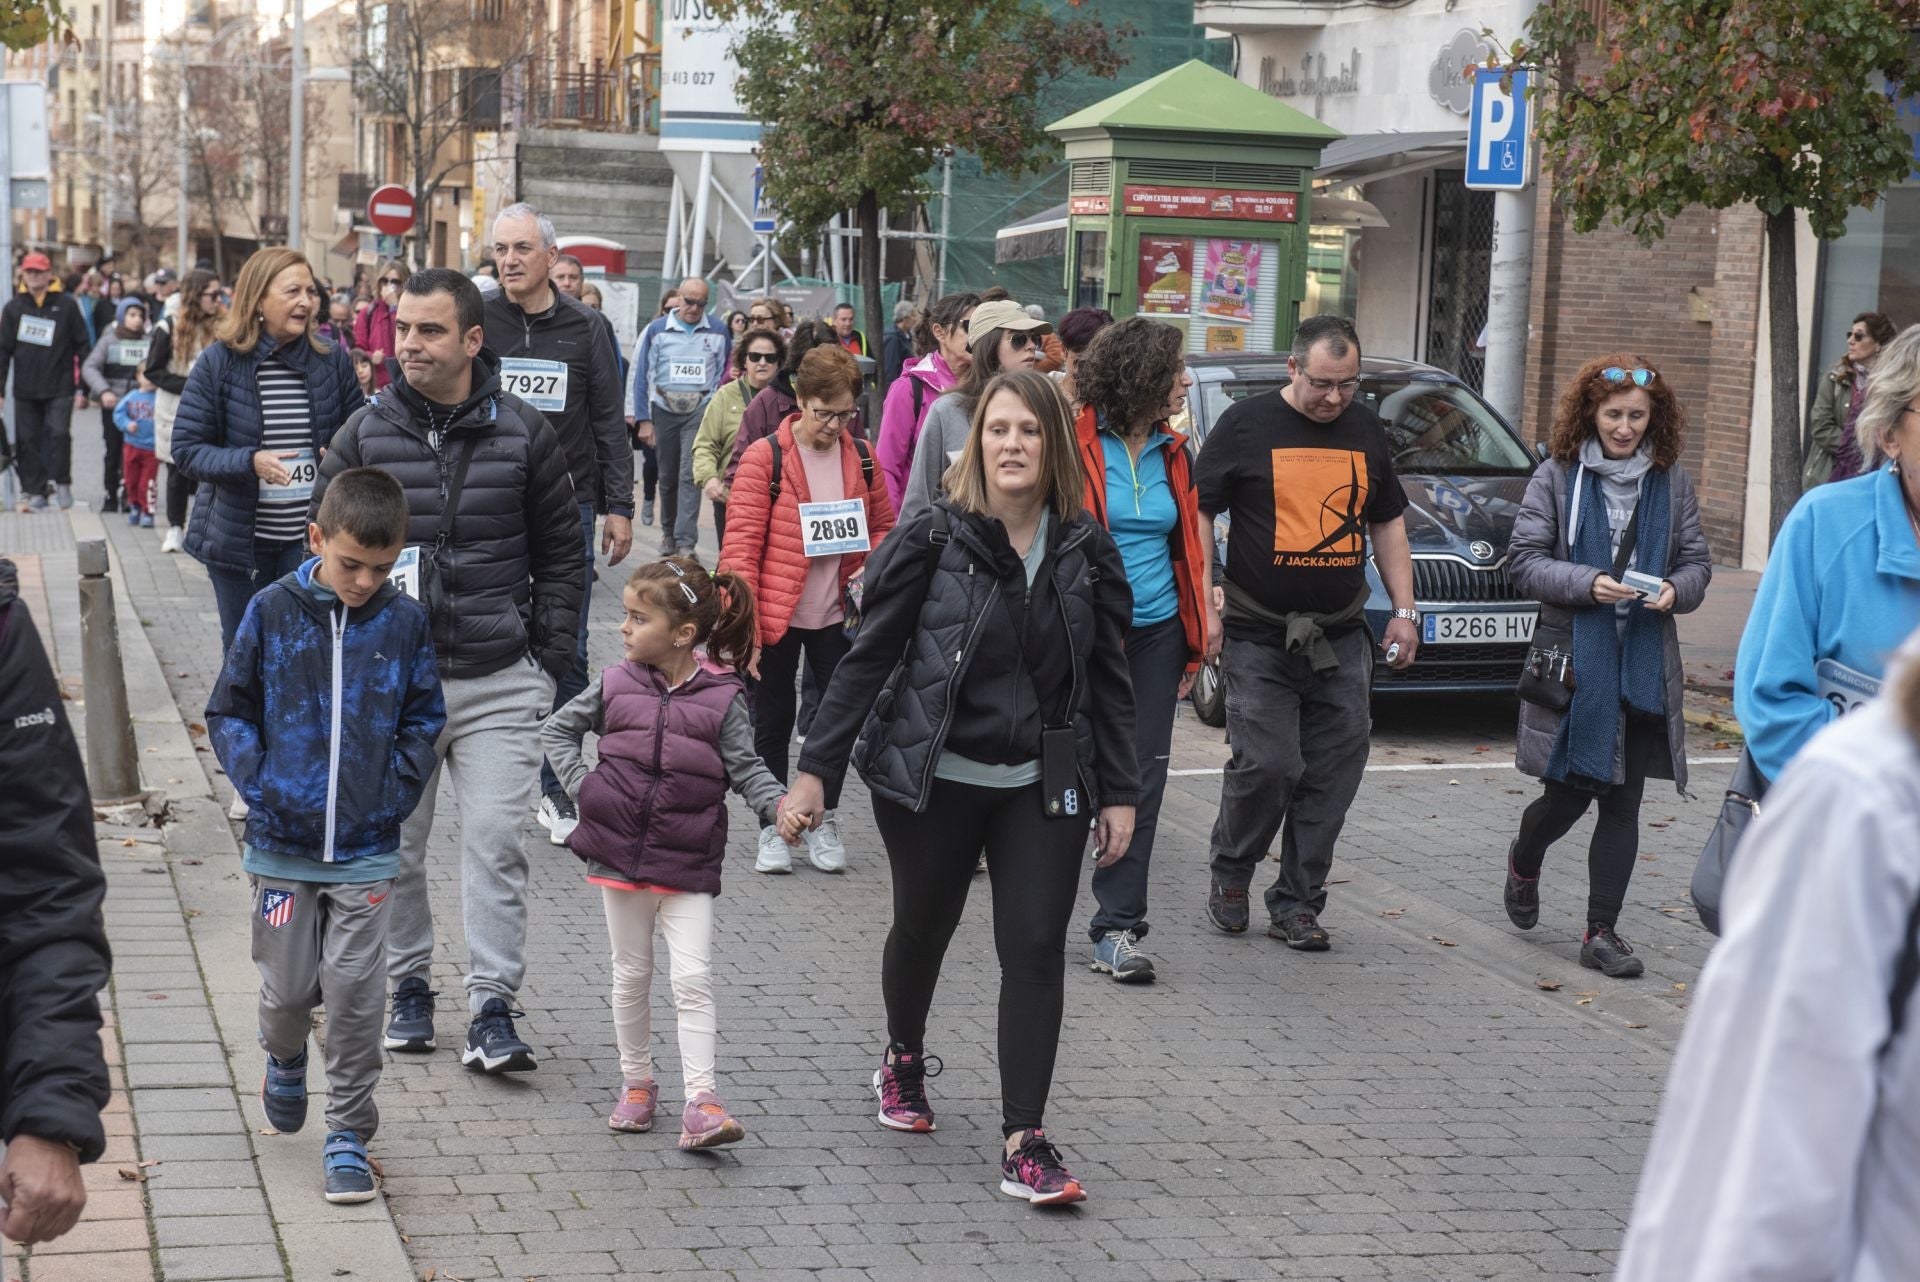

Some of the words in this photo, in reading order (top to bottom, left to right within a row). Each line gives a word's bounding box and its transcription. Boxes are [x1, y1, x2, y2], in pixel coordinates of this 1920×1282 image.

[692, 72, 715, 85] 027
[1478, 82, 1514, 171] P
[674, 365, 701, 375] 7460
[506, 374, 559, 394] 7927
[810, 517, 859, 541] 2889
[1286, 556, 1356, 567] JACK&JONES
[1440, 617, 1497, 639] 3266
[1832, 669, 1875, 692] MARCHA
